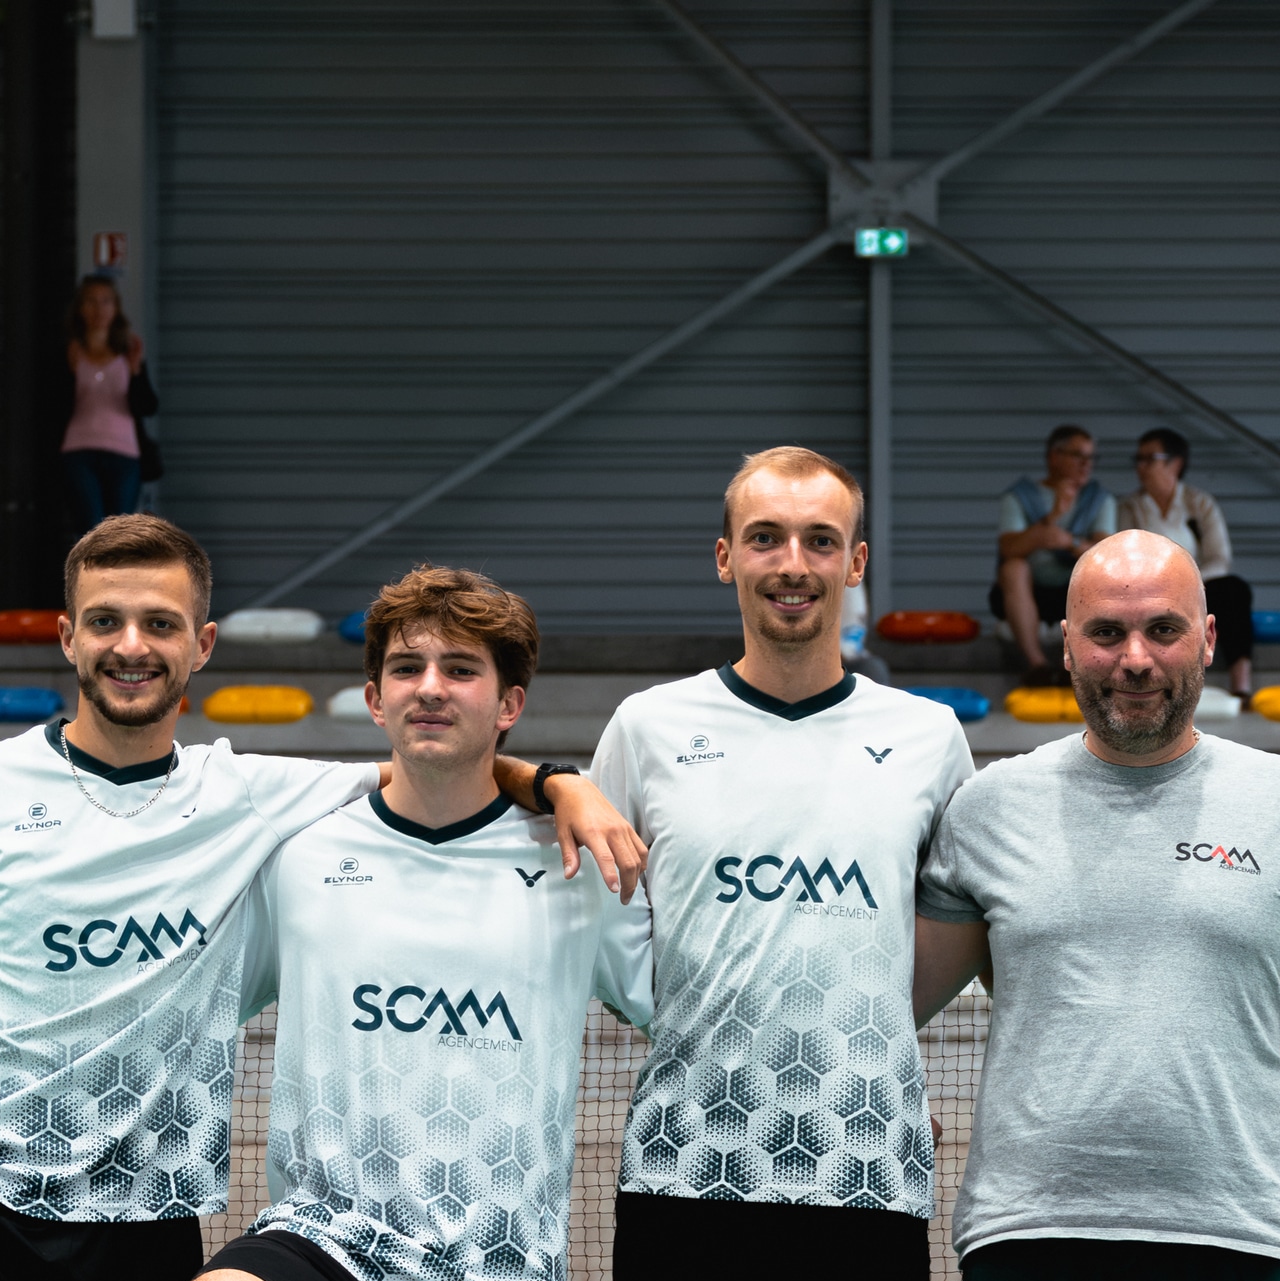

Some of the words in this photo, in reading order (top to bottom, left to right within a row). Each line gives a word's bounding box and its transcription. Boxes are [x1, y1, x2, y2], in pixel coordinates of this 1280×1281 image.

[676, 751, 725, 763] ELYNOR
[14, 819, 62, 832] ELYNOR
[324, 875, 373, 884] ELYNOR
[793, 903, 880, 920] AGENCEMENT
[437, 1034, 524, 1053] AGENCEMENT
